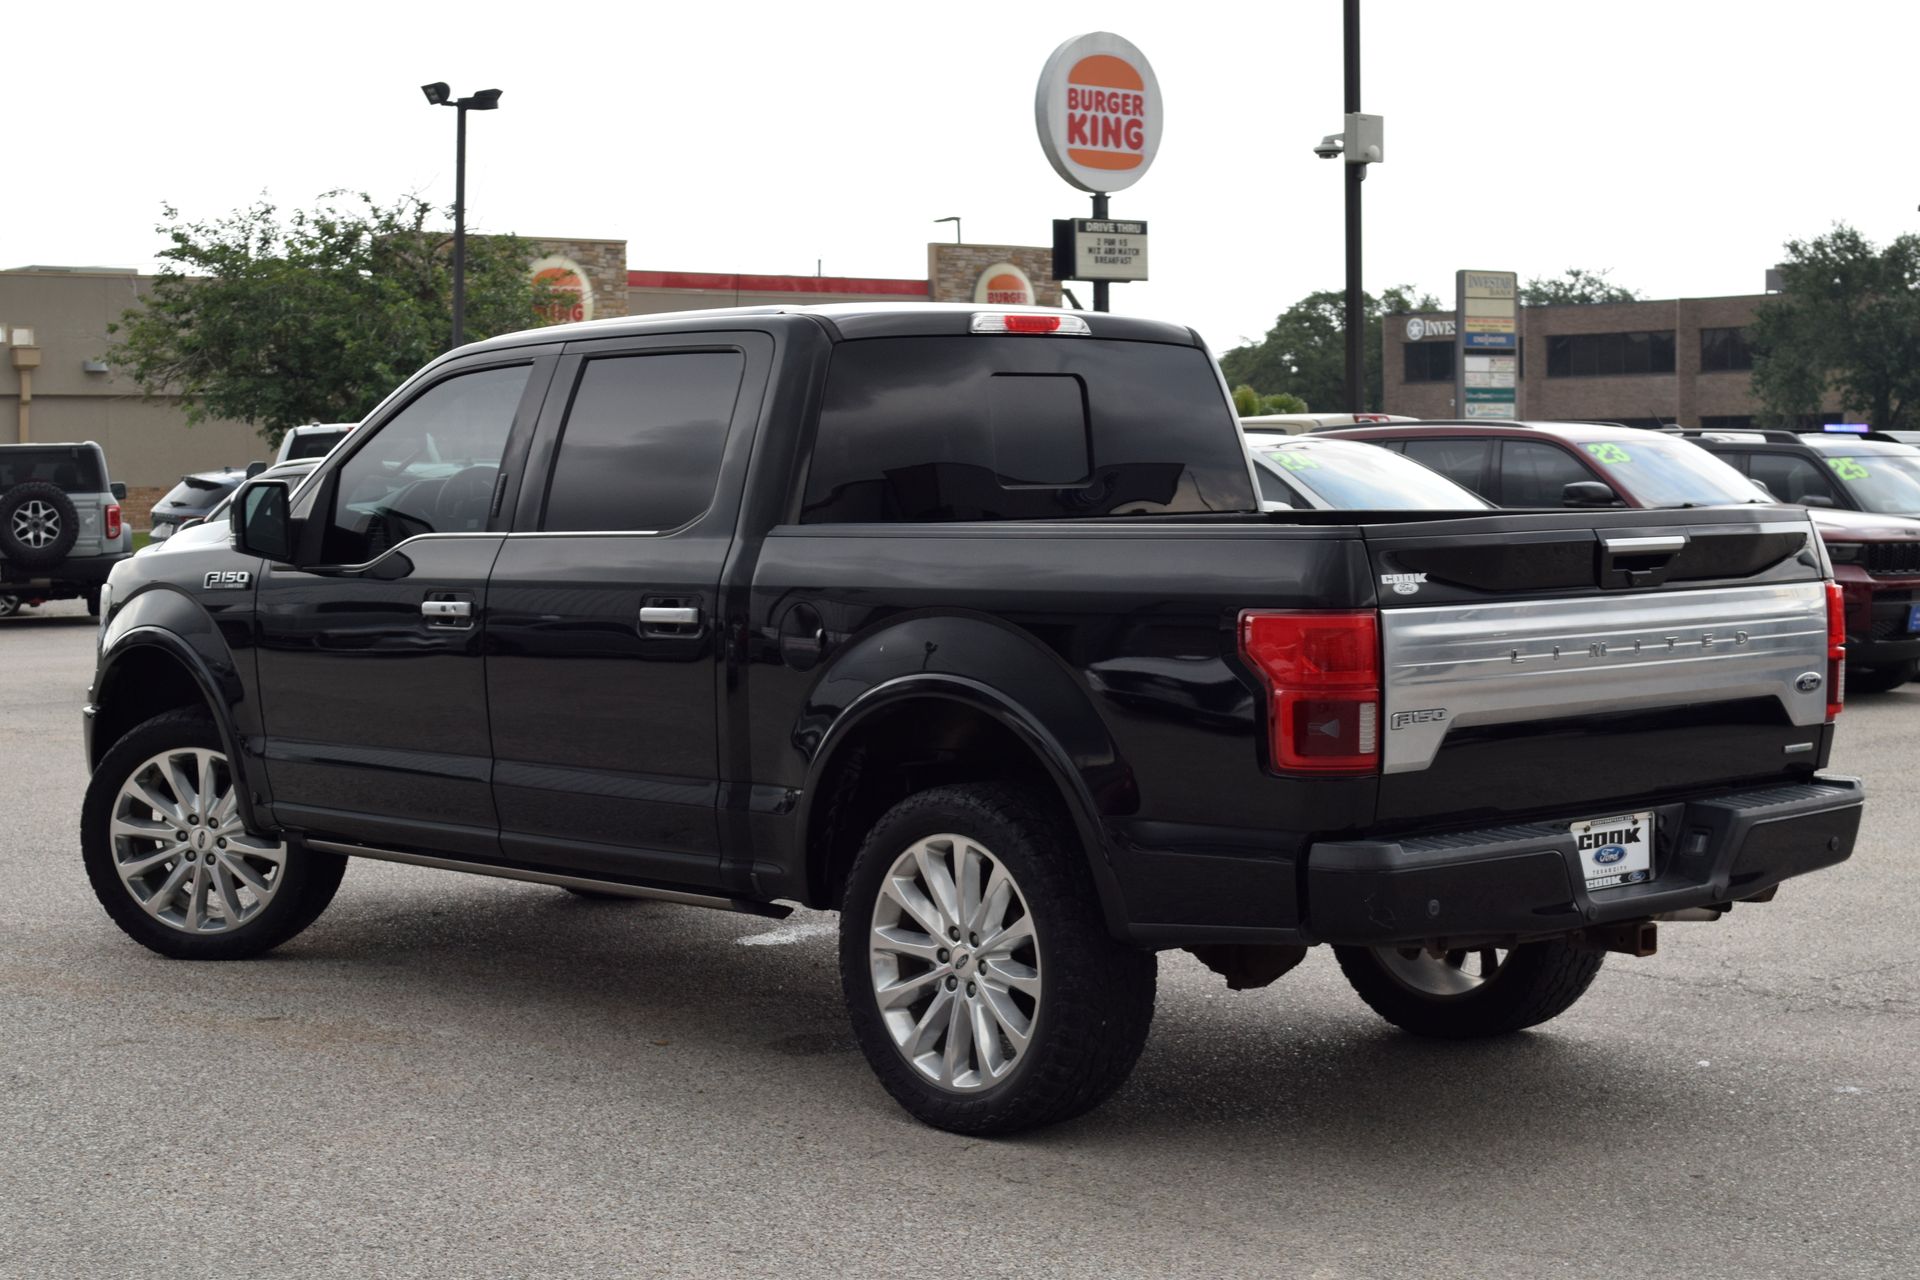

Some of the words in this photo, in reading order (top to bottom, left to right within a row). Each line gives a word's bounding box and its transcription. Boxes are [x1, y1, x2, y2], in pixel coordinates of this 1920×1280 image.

[1067, 87, 1144, 117] BURGER
[1067, 111, 1144, 151] KING
[1086, 222, 1115, 233] DRIVE
[1116, 223, 1141, 234] THRU
[1094, 255, 1132, 265] BREAKFAST
[1468, 274, 1513, 289] INVESTAR
[1586, 442, 1631, 464] 23
[1827, 457, 1870, 481] 25
[1381, 573, 1428, 584] COOK
[1510, 630, 1749, 664] LIMITED
[1578, 827, 1641, 850] COOK
[1586, 876, 1622, 888] COOK
